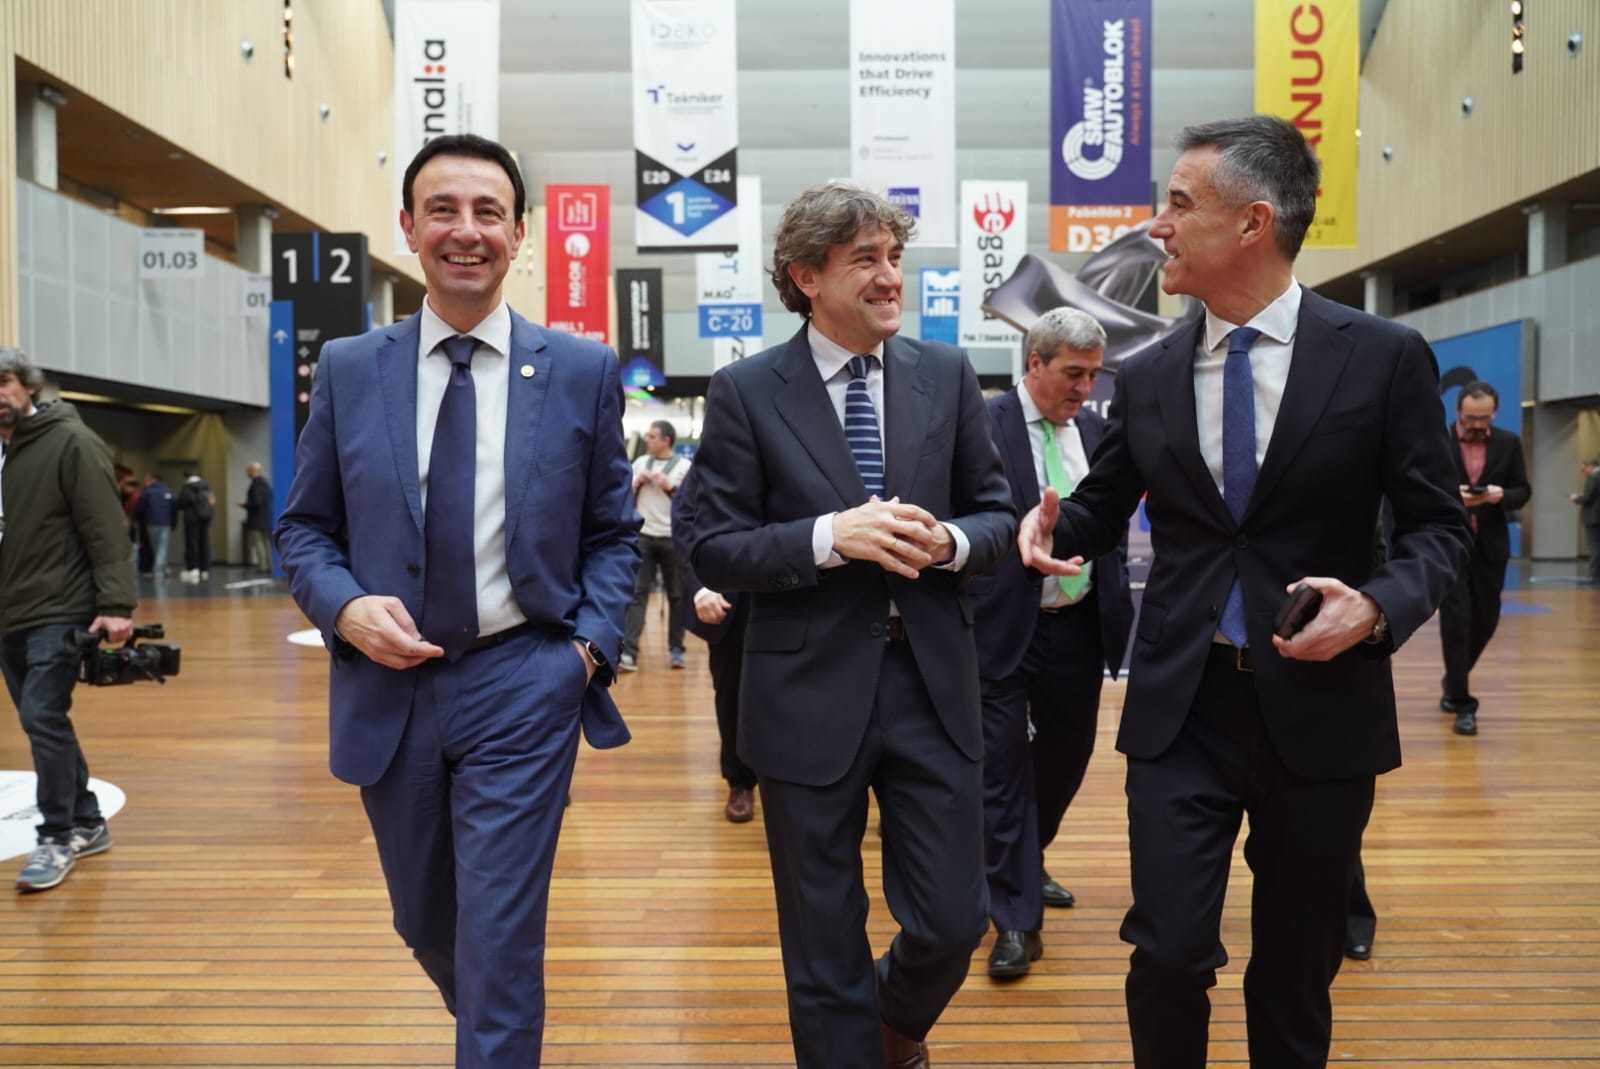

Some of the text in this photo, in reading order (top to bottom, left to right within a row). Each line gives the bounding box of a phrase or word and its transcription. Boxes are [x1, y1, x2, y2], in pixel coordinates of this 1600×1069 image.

[858, 51, 946, 63] Innovations
[859, 68, 933, 80] that Drive
[859, 85, 931, 99] Efficiency
[1104, 18, 1125, 149] AUTOBLOK
[666, 92, 723, 104] Tekniker
[665, 191, 685, 225] 1
[143, 251, 198, 269] 01.03
[282, 249, 297, 284] 1
[330, 249, 352, 284] 2
[708, 315, 753, 332] C-20
